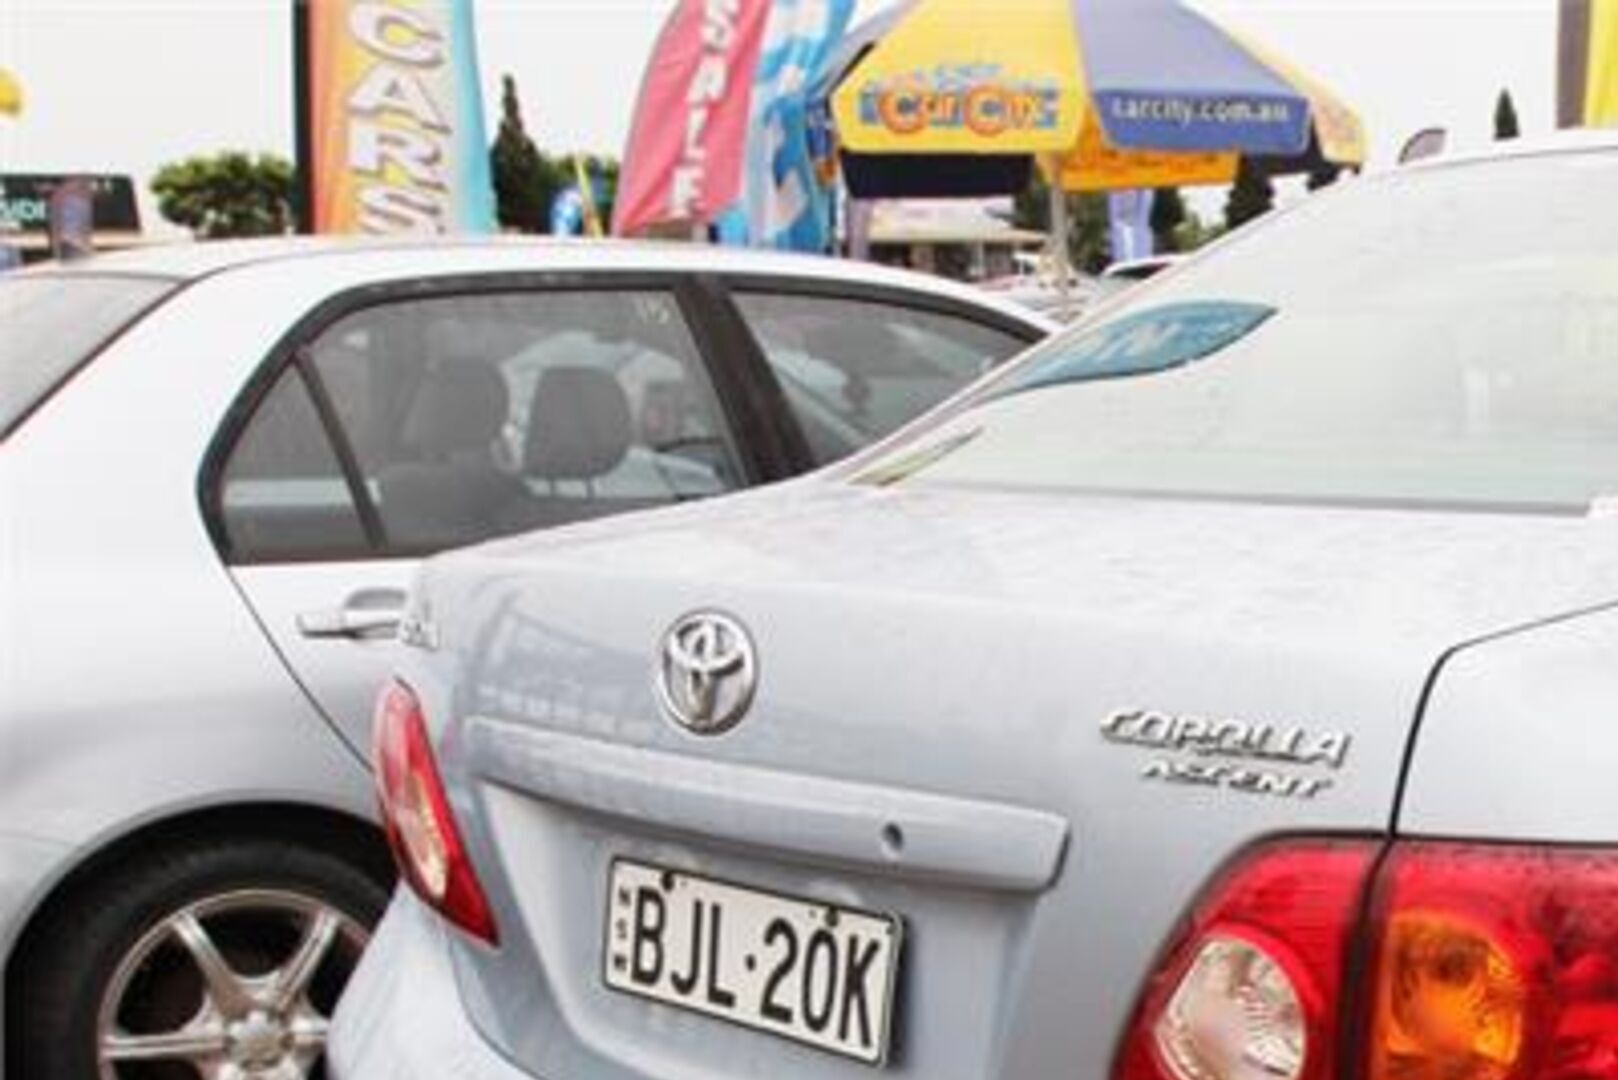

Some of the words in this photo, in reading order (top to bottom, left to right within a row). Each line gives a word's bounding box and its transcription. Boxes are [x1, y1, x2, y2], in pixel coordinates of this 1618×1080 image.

[346, 0, 452, 236] CARS
[667, 0, 743, 218] SALE
[1110, 97, 1289, 127] carcity.com.au
[1099, 709, 1352, 770] COROLLA
[1140, 760, 1334, 798] ASCENT
